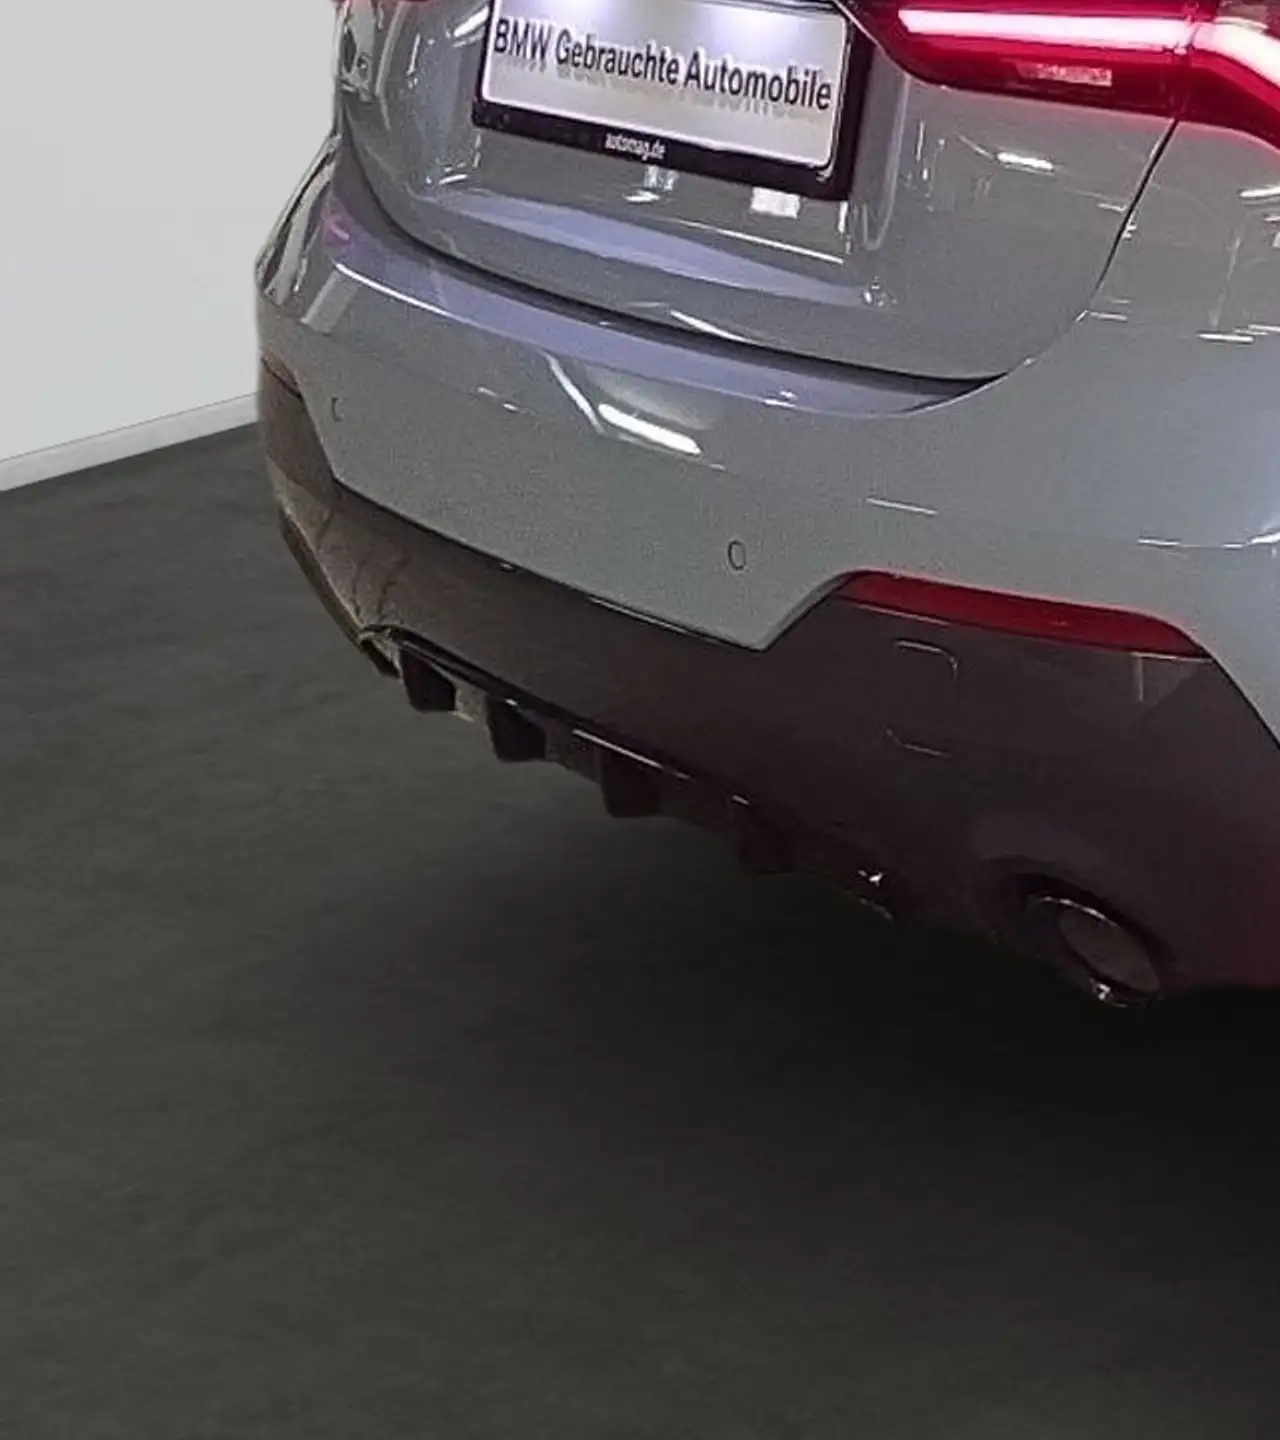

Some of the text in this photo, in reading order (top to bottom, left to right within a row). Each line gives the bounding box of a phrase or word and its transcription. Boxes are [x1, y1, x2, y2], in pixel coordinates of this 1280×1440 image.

[494, 18, 832, 111] BMW Gebrauchte Automobile
[604, 132, 666, 162] automag.de
